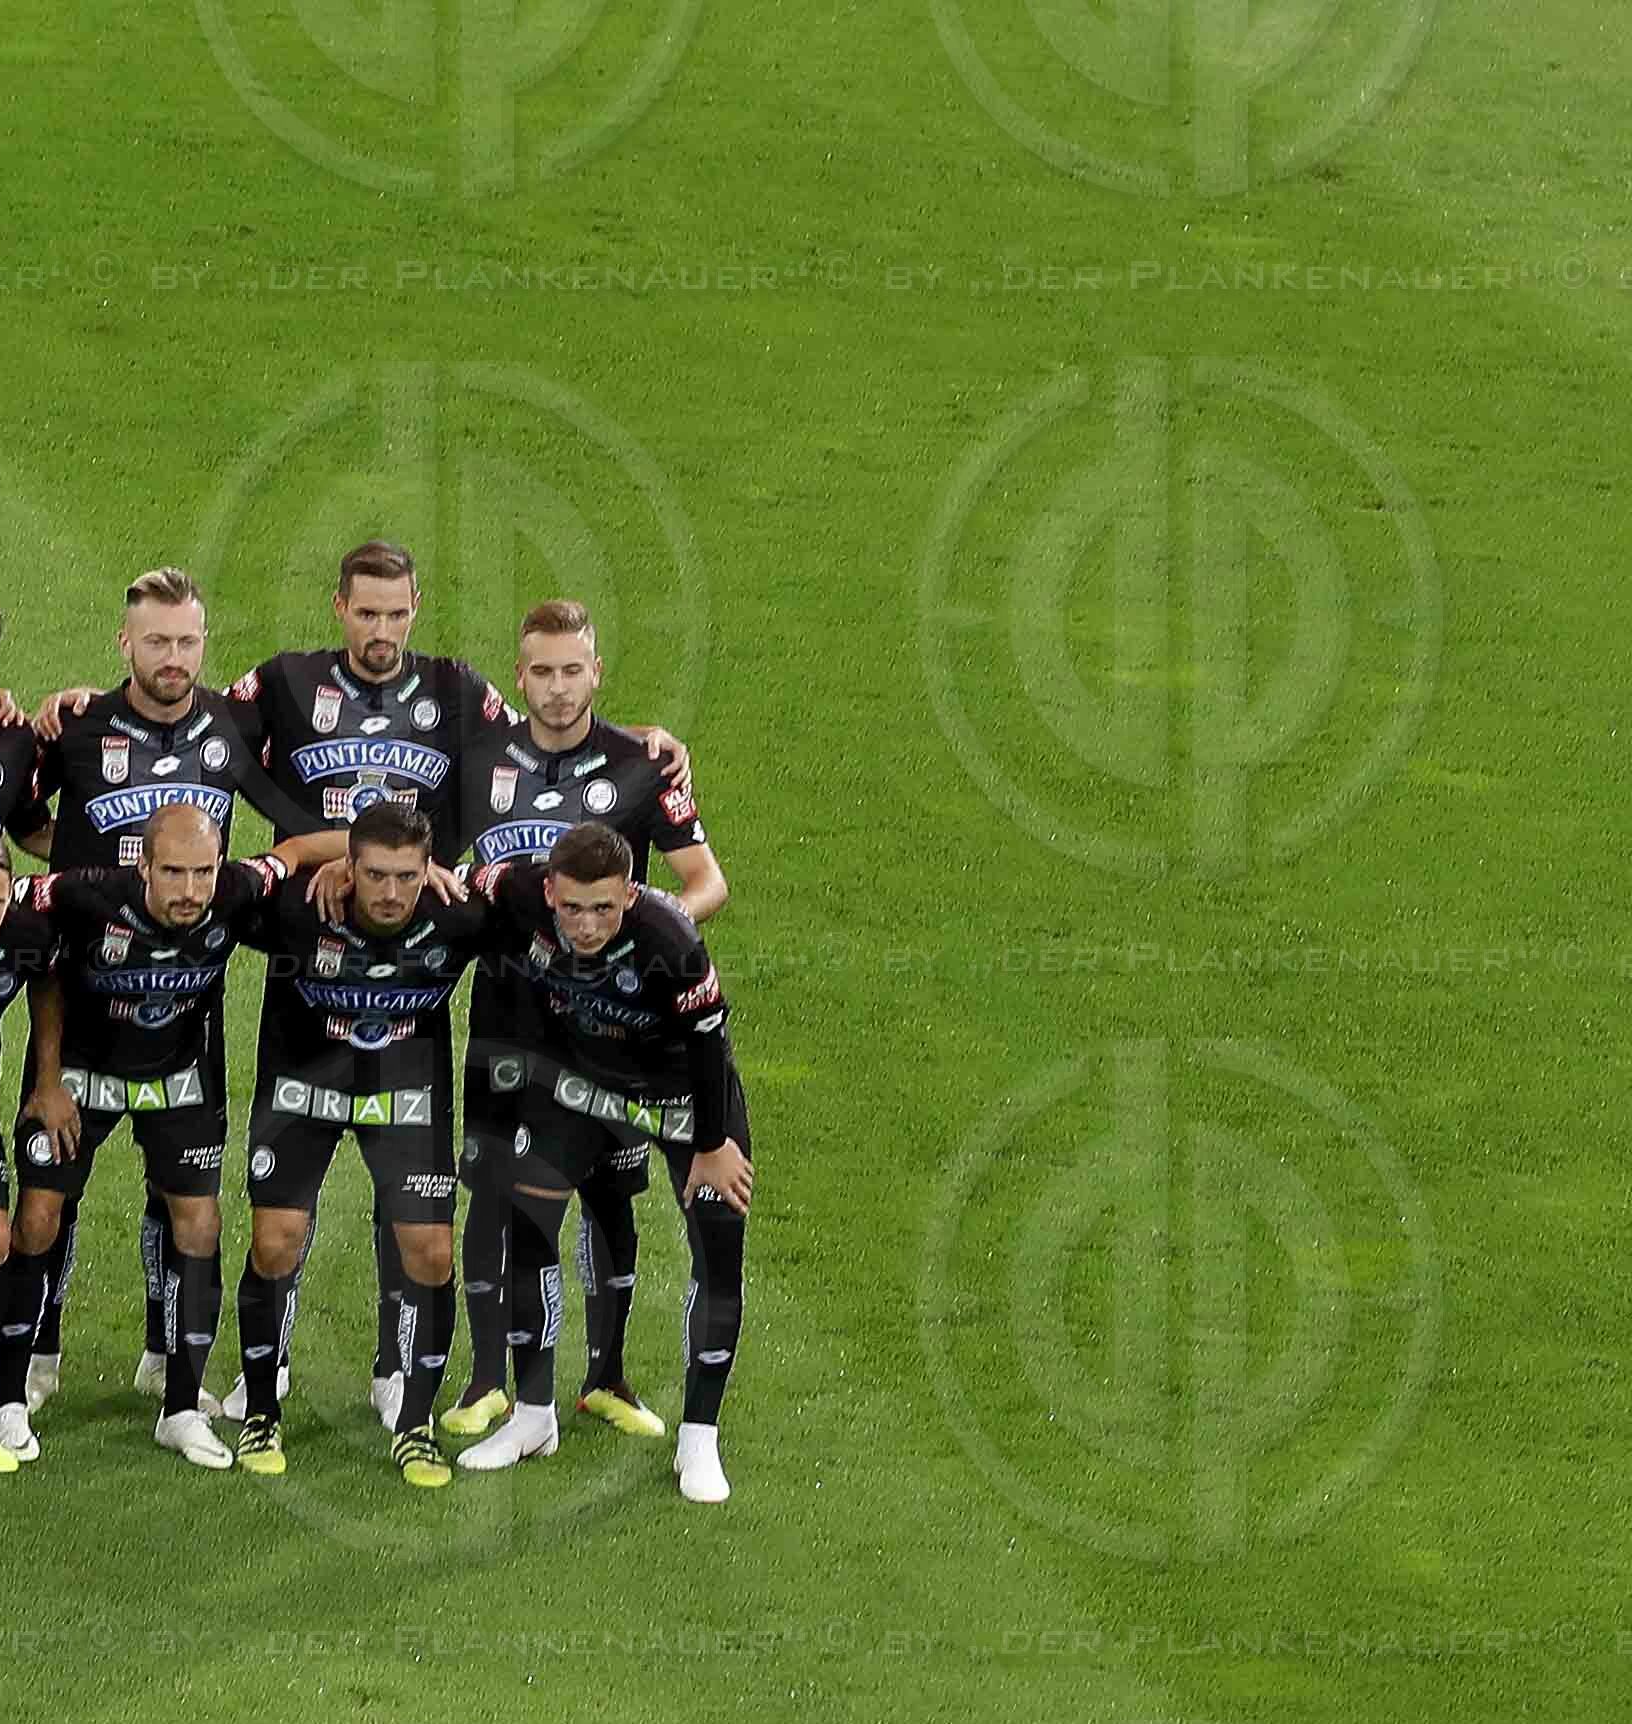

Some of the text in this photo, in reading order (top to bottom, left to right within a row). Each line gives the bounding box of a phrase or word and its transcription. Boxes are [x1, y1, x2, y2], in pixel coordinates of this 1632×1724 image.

[298, 743, 445, 781] PUNTIGAMER
[484, 826, 558, 857] PUNTIG
[279, 1081, 428, 1124] GRAZ
